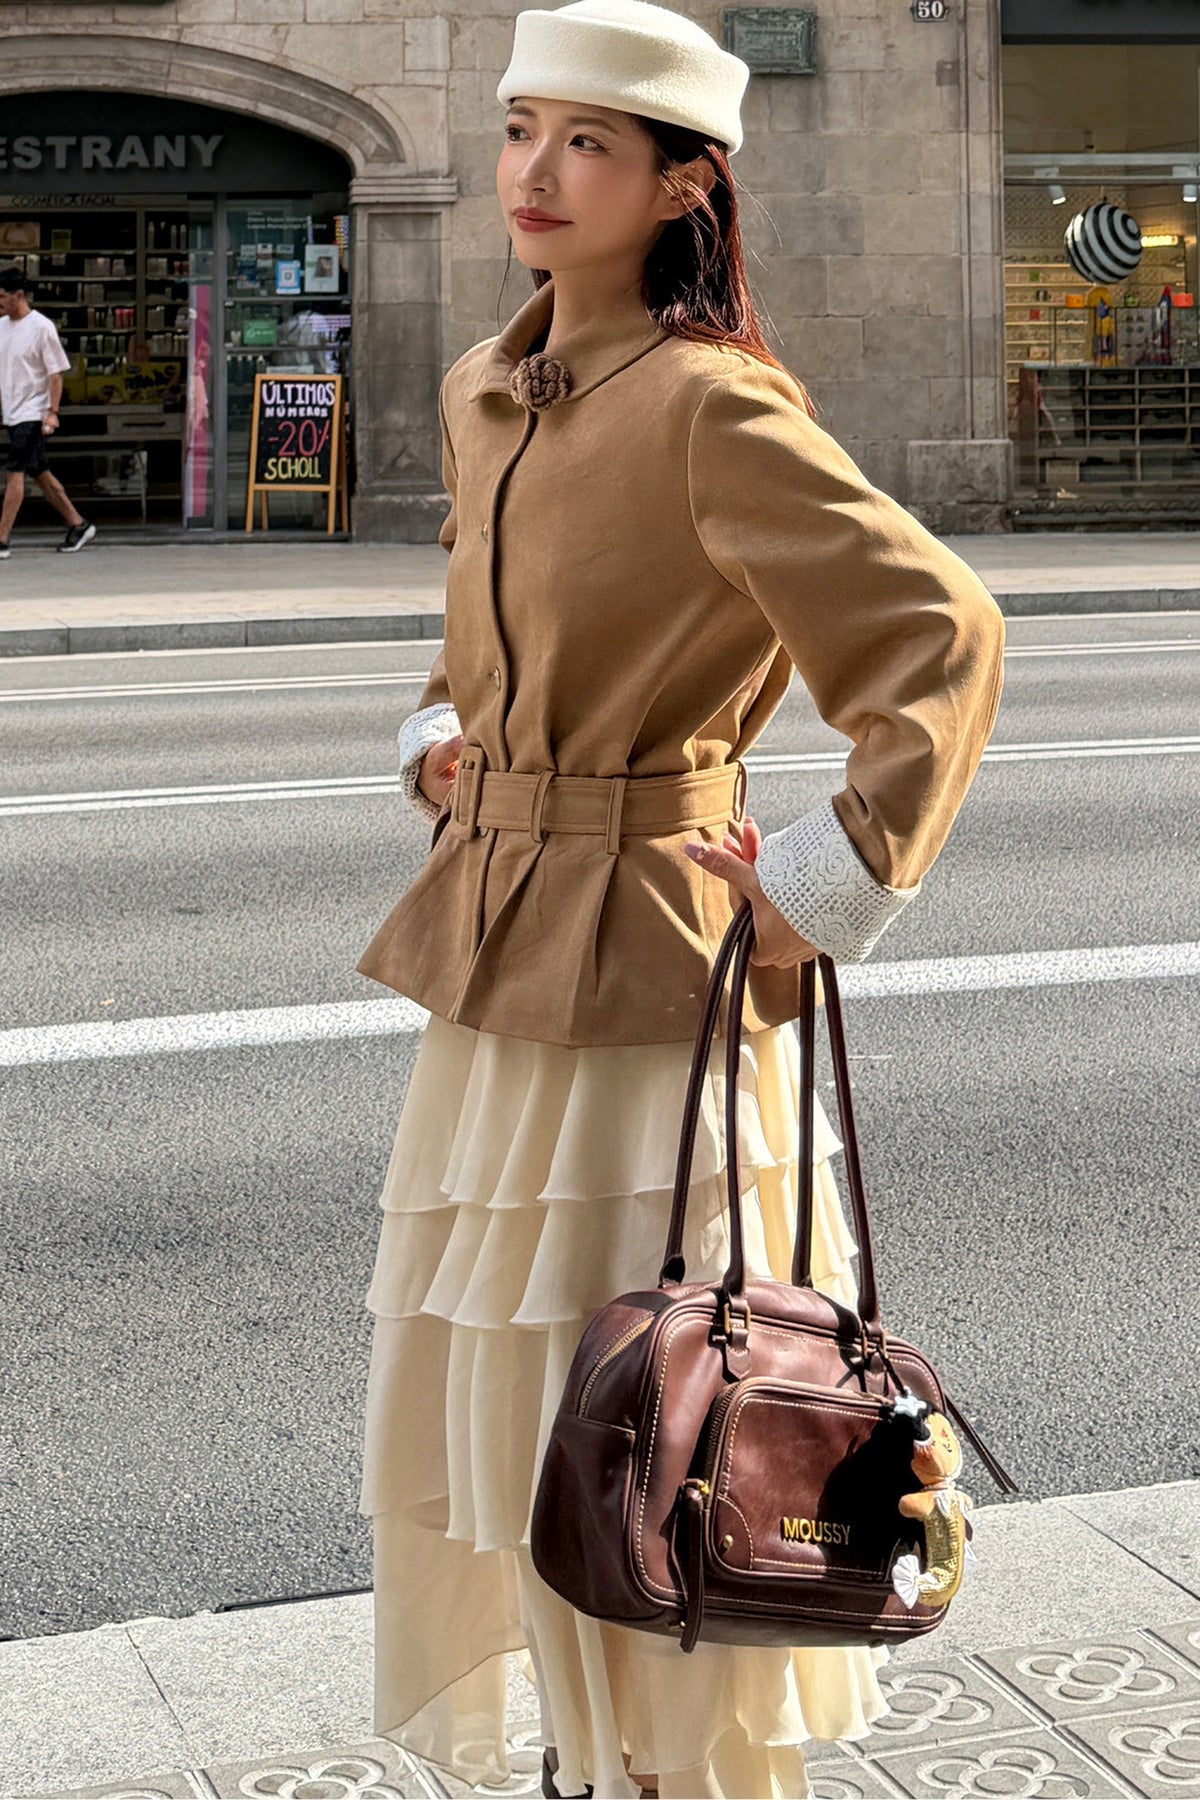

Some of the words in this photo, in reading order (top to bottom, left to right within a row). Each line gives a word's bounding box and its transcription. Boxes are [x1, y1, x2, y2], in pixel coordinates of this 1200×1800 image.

[918, 0, 943, 18] 50
[262, 381, 336, 406] ÚLTIMOS
[265, 404, 329, 418] NÚMEROS
[264, 457, 322, 480] SCHOLL
[782, 1516, 851, 1546] MOUSSY
